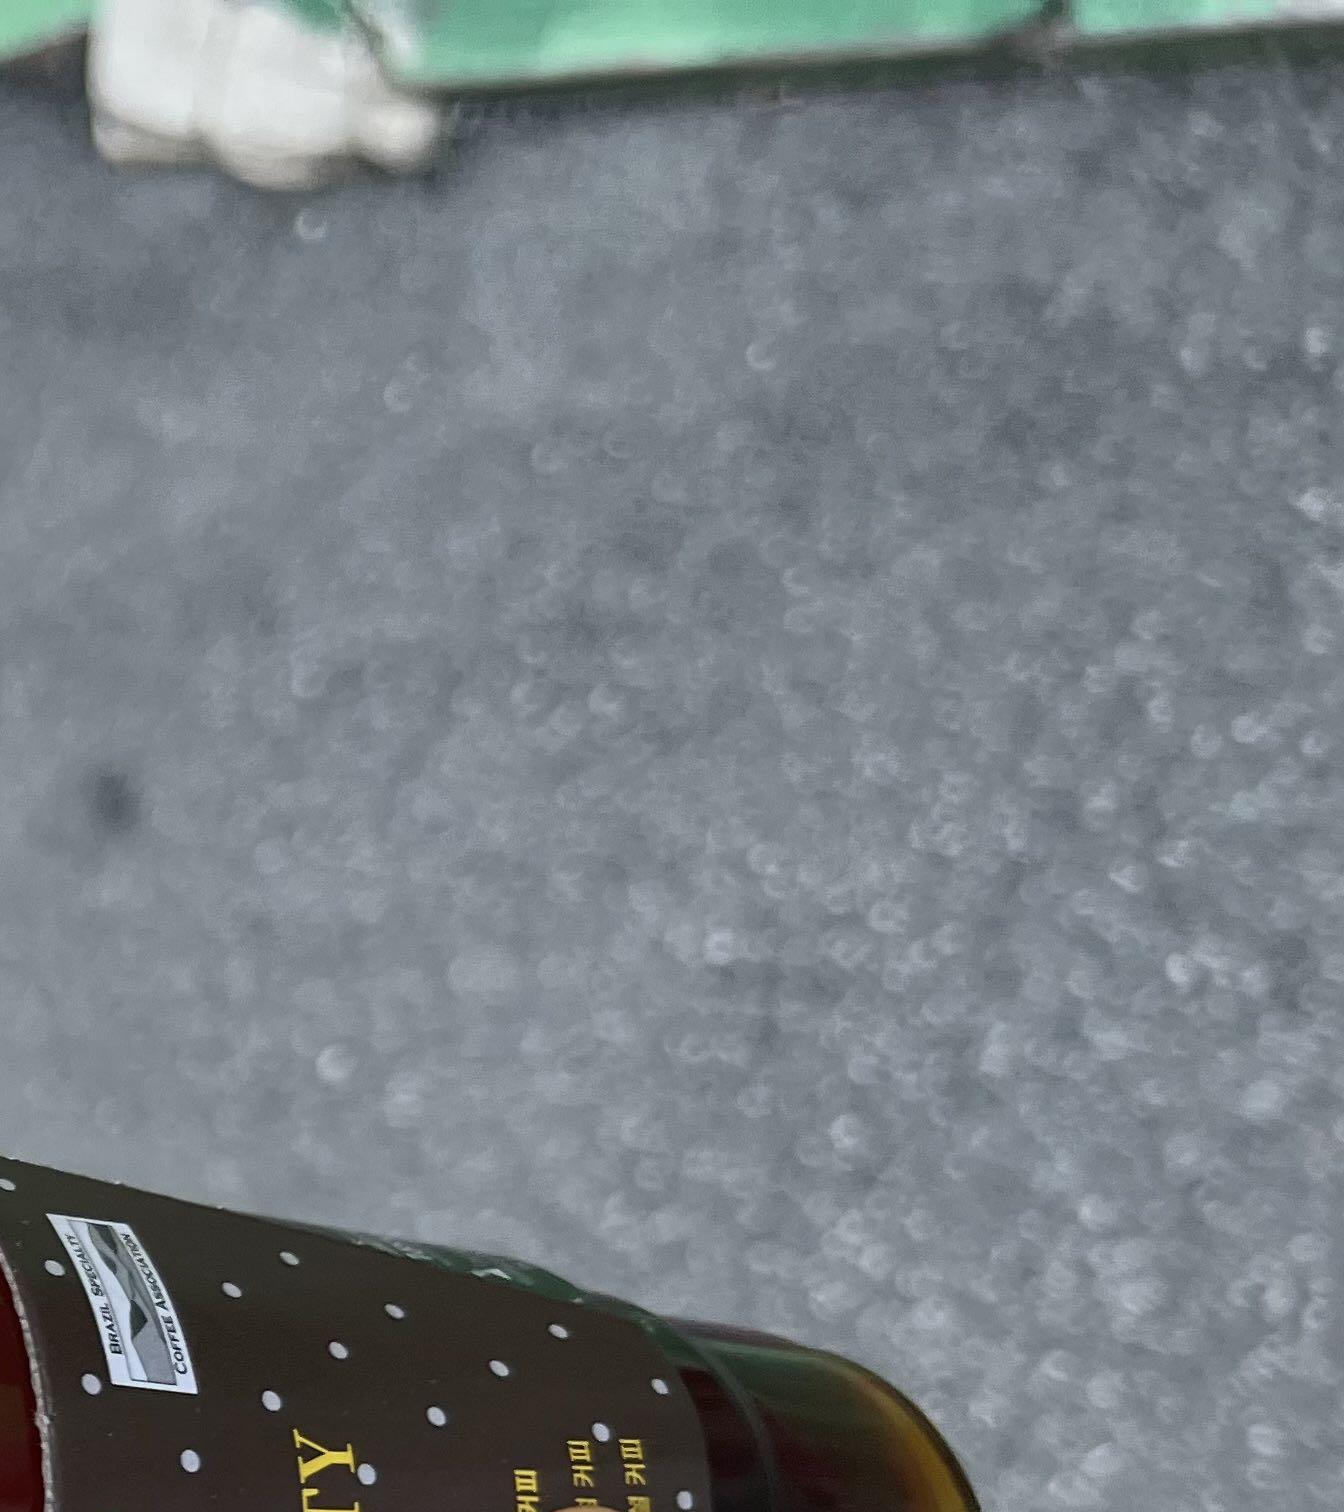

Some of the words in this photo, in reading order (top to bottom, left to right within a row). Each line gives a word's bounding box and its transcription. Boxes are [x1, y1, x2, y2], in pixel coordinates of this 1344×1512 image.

[65, 1234, 102, 1295] SPECIALTY
[121, 1234, 168, 1310] ASSOCIATION
[101, 1304, 122, 1354] BRAZIL
[163, 1316, 187, 1374] COFFEE
[567, 1441, 594, 1486] 커피
[619, 1440, 645, 1484] 커피
